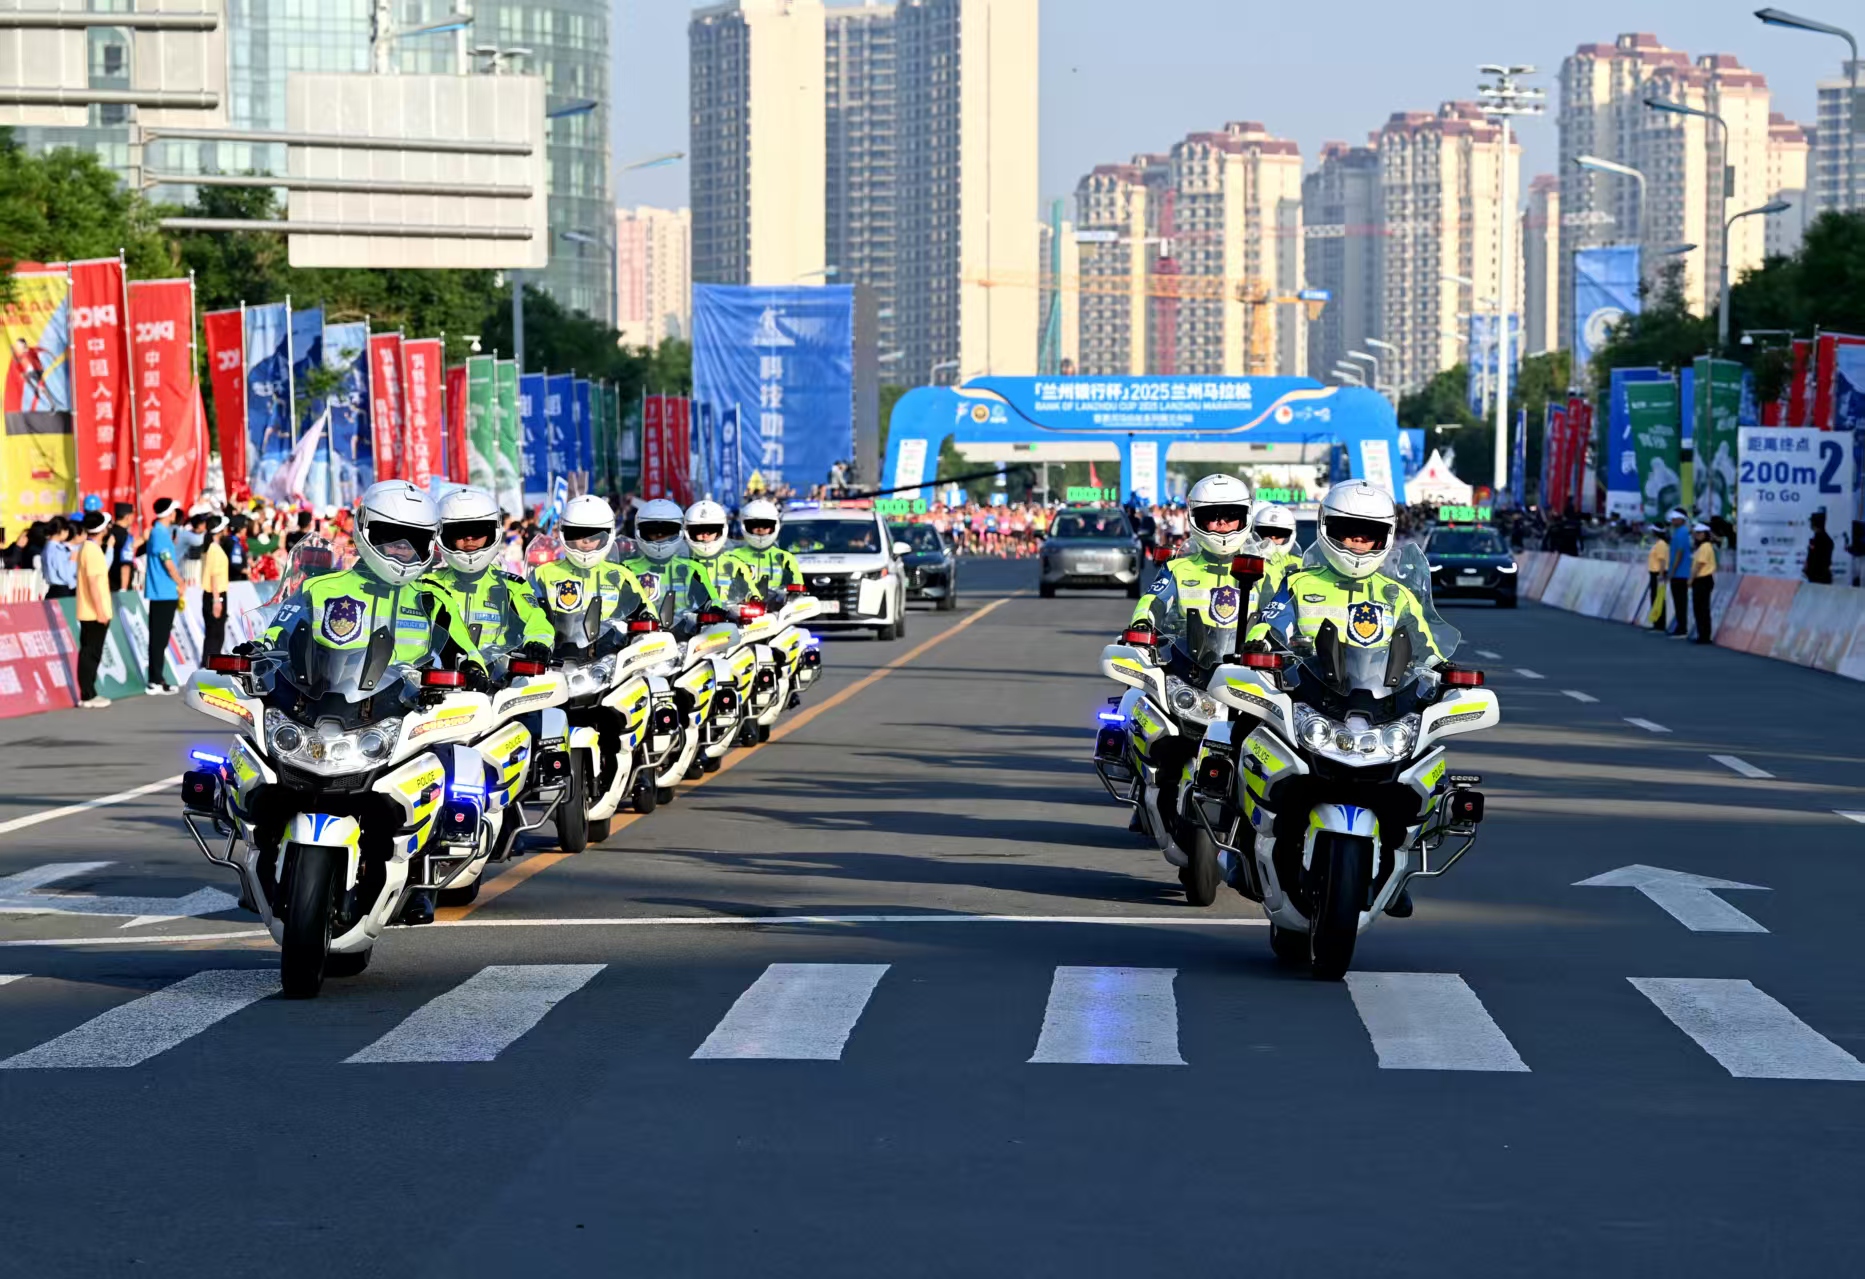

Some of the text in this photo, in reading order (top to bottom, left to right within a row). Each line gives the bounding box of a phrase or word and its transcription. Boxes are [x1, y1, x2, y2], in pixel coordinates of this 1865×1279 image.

[1075, 401, 1117, 411] LANZHOU
[1159, 401, 1202, 411] LANZHOU
[1748, 436, 1810, 451] 距离终点
[1740, 461, 1817, 485] 200m
[1819, 440, 1843, 494] 2
[1757, 489, 1800, 502] To Go
[1253, 743, 1270, 763] POLICE
[417, 771, 436, 788] POLICE
